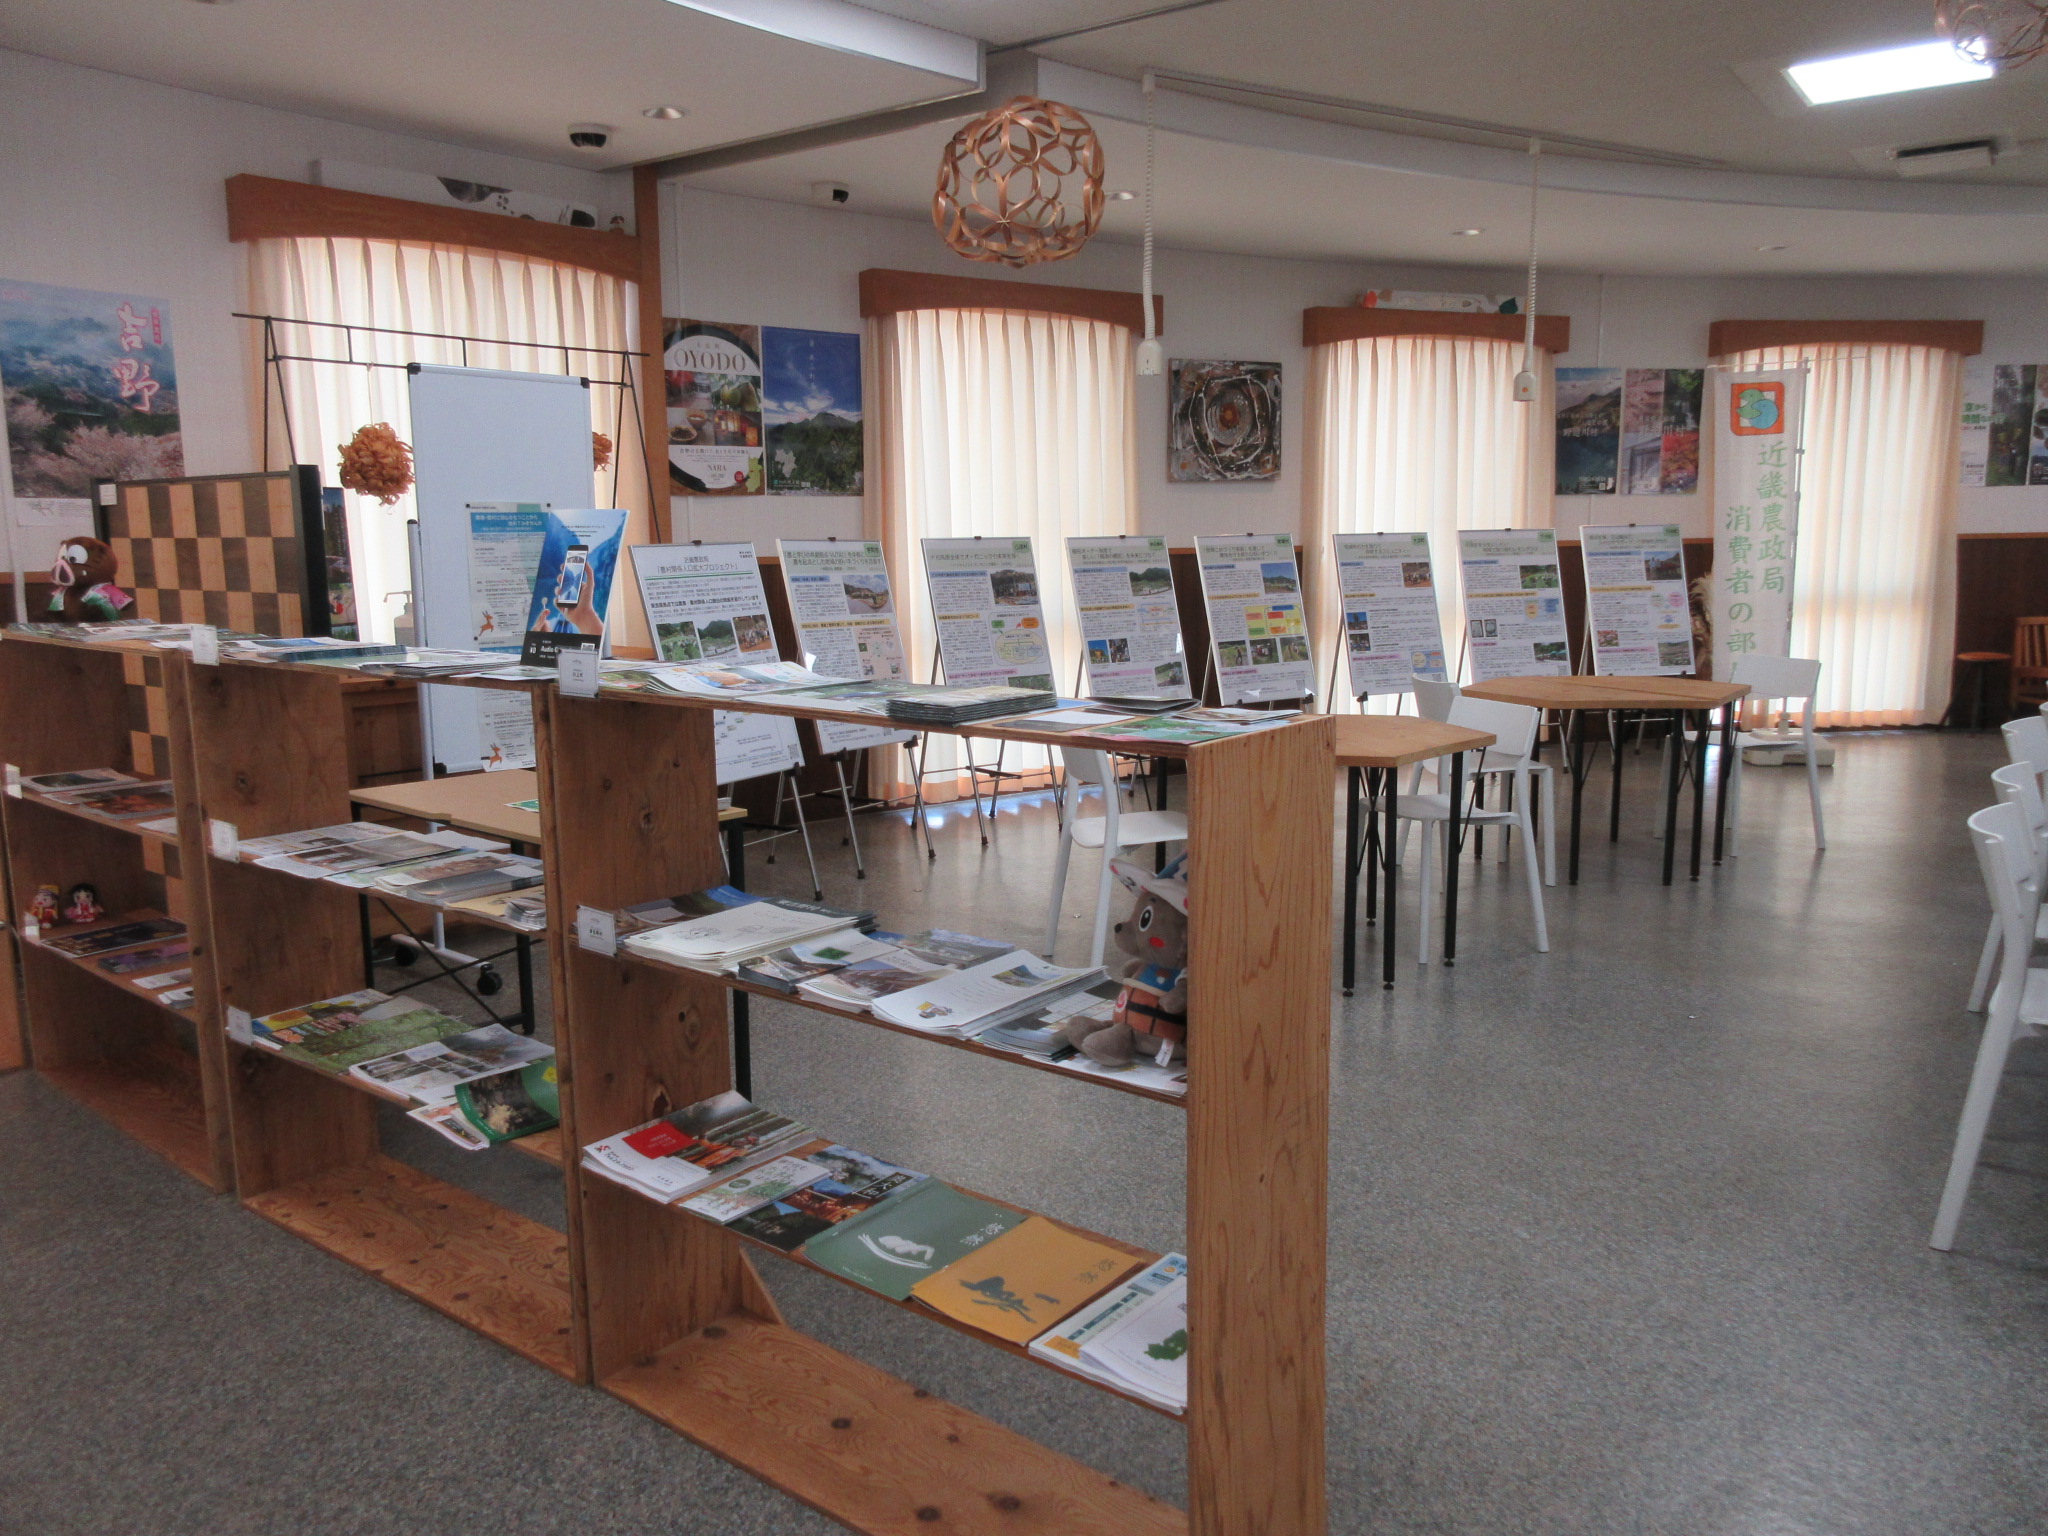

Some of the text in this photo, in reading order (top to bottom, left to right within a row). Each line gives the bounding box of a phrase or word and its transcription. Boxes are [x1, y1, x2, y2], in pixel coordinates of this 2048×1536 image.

[116, 302, 160, 415] 吉野
[673, 349, 747, 373] OYODO
[706, 463, 728, 472] NARA
[1756, 440, 1788, 594] 近畿農政局
[657, 563, 738, 574] 「農村関係人口拡大プロジェクト」
[684, 555, 710, 564] 近畿農政局
[1725, 504, 1757, 682] 消費者の部
